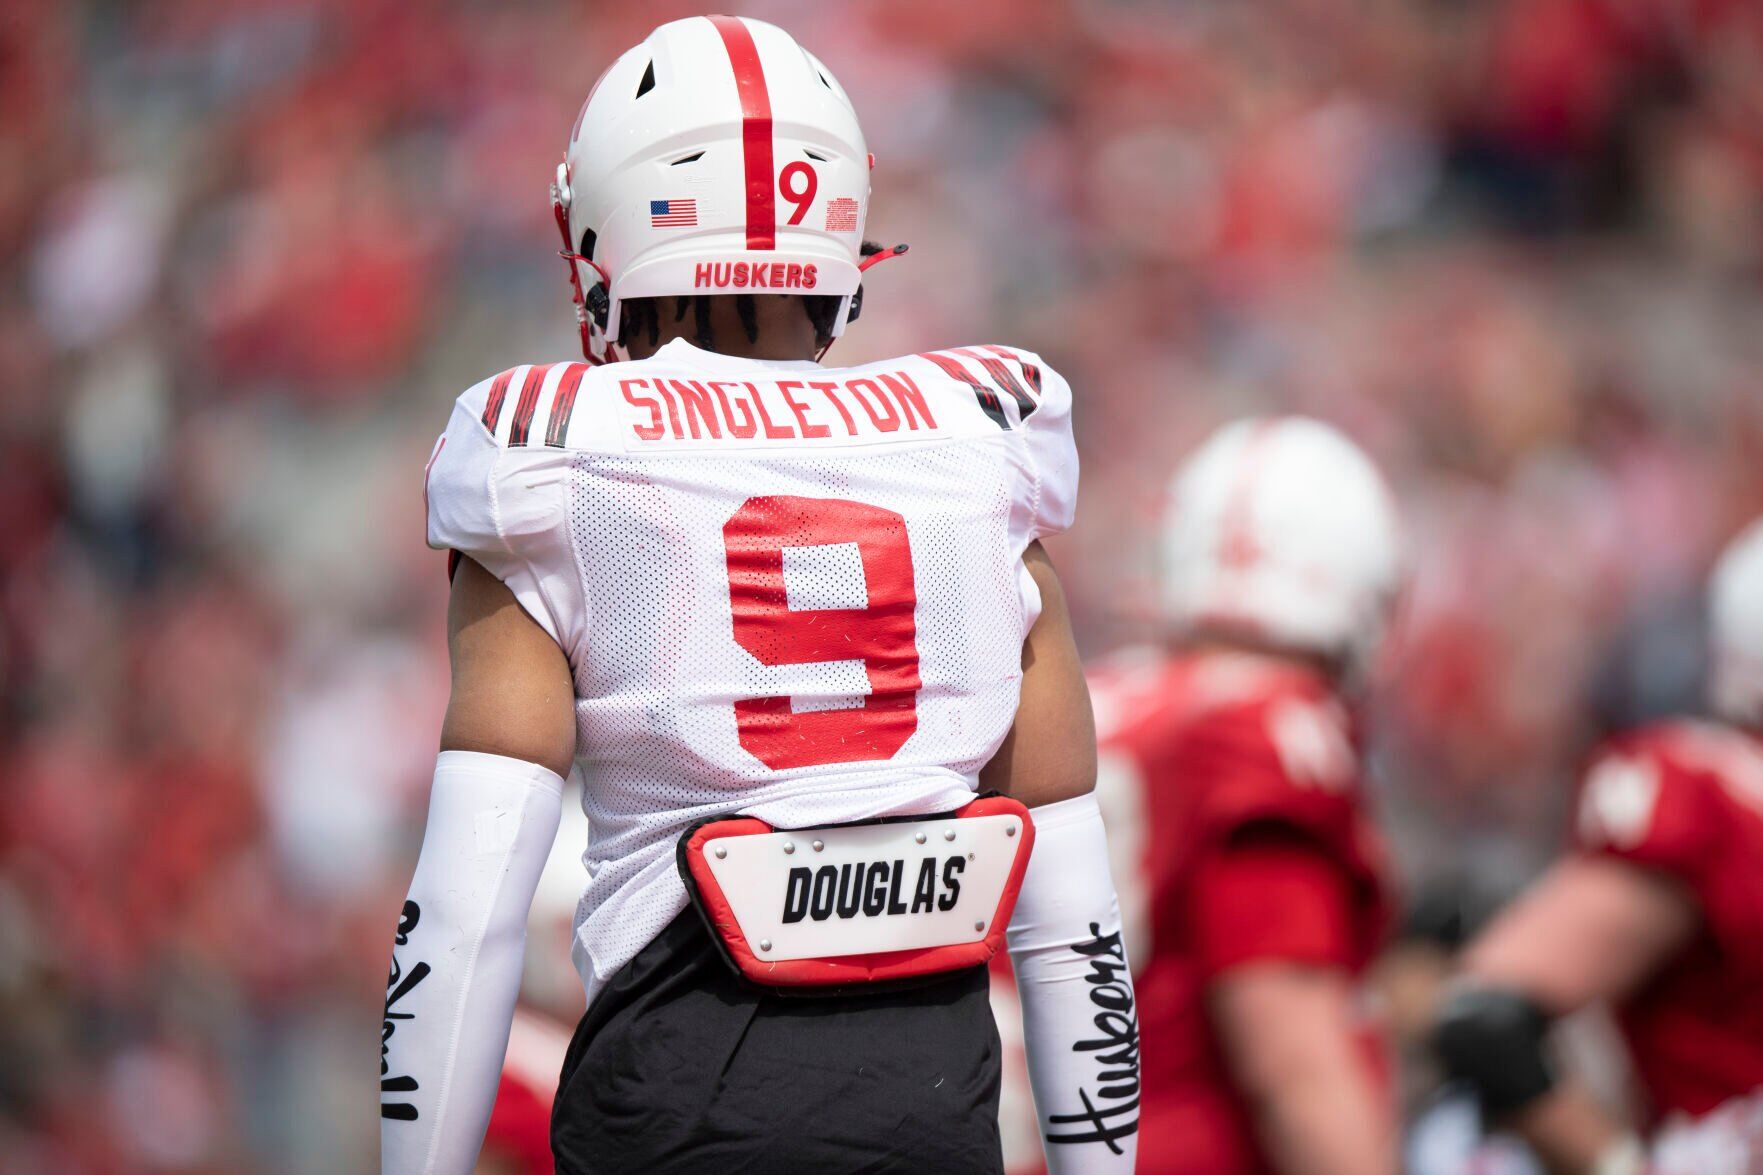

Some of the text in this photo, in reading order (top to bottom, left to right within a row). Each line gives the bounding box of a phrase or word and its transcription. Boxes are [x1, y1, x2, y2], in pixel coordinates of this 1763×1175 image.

[778, 160, 818, 226] 9
[694, 262, 818, 289] HUSKERS
[619, 371, 939, 441] SINGLETON
[722, 495, 923, 770] 9
[782, 856, 966, 924] DOUGLAS
